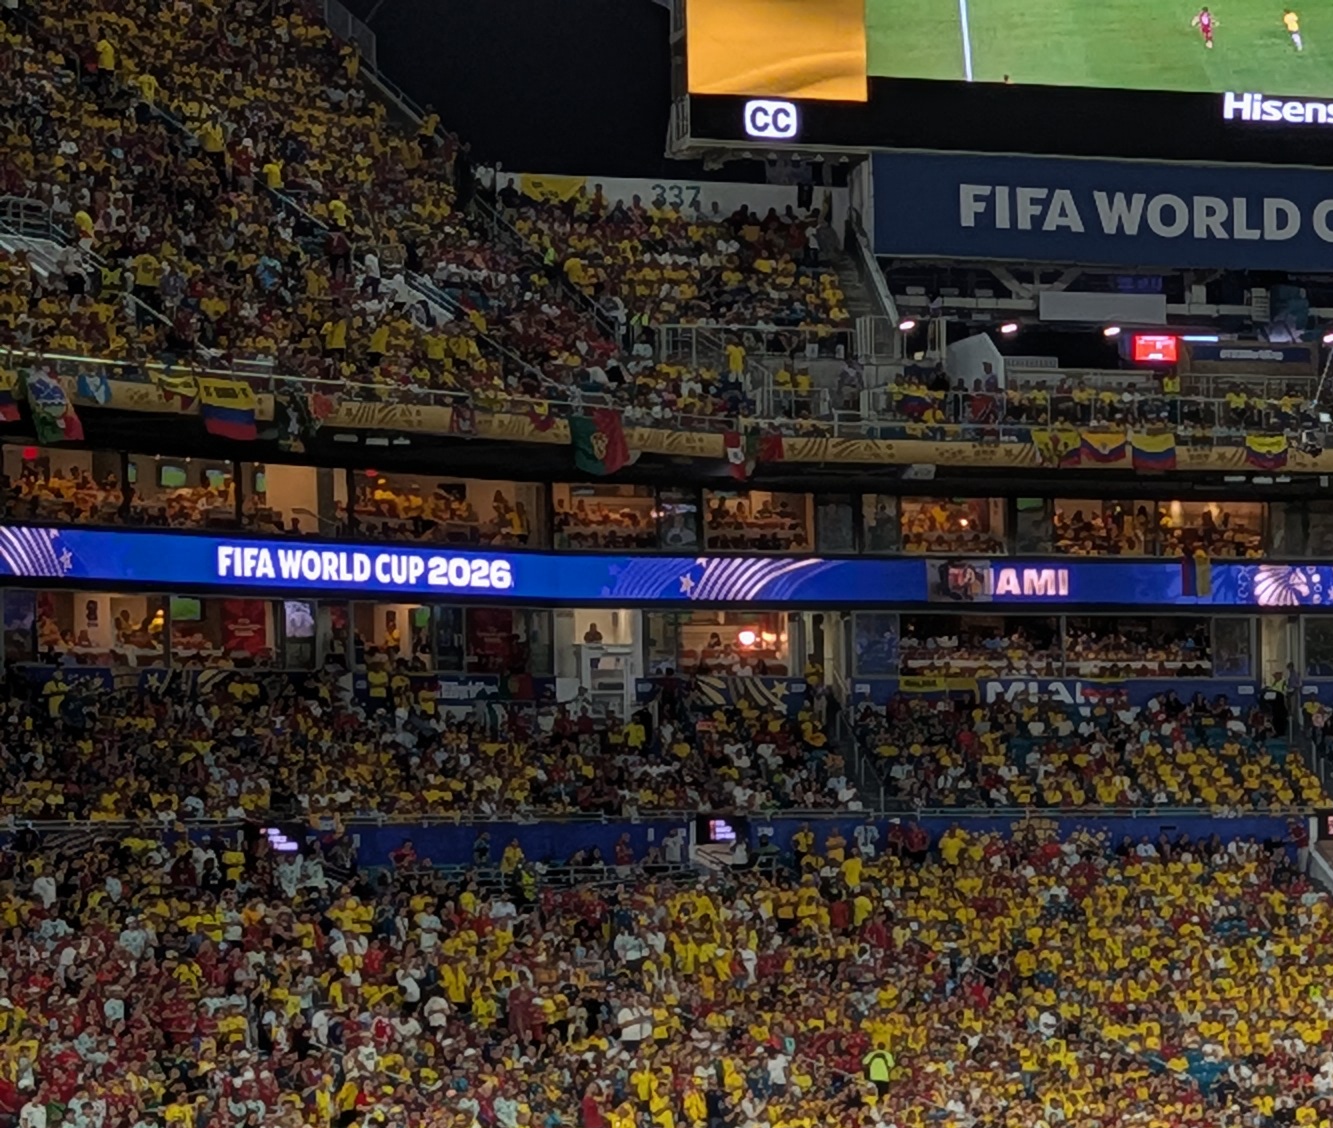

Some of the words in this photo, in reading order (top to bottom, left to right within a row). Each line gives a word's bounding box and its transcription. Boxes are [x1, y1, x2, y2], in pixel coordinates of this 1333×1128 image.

[750, 106, 791, 133] CC
[651, 183, 701, 209] 337
[959, 183, 1085, 233] FIFA
[1092, 190, 1301, 241] WORLD
[217, 545, 276, 579] FIFA
[278, 549, 371, 582] WORLD
[375, 553, 425, 585] CUP
[427, 556, 512, 589] 2026
[950, 567, 1069, 596] IAMI
